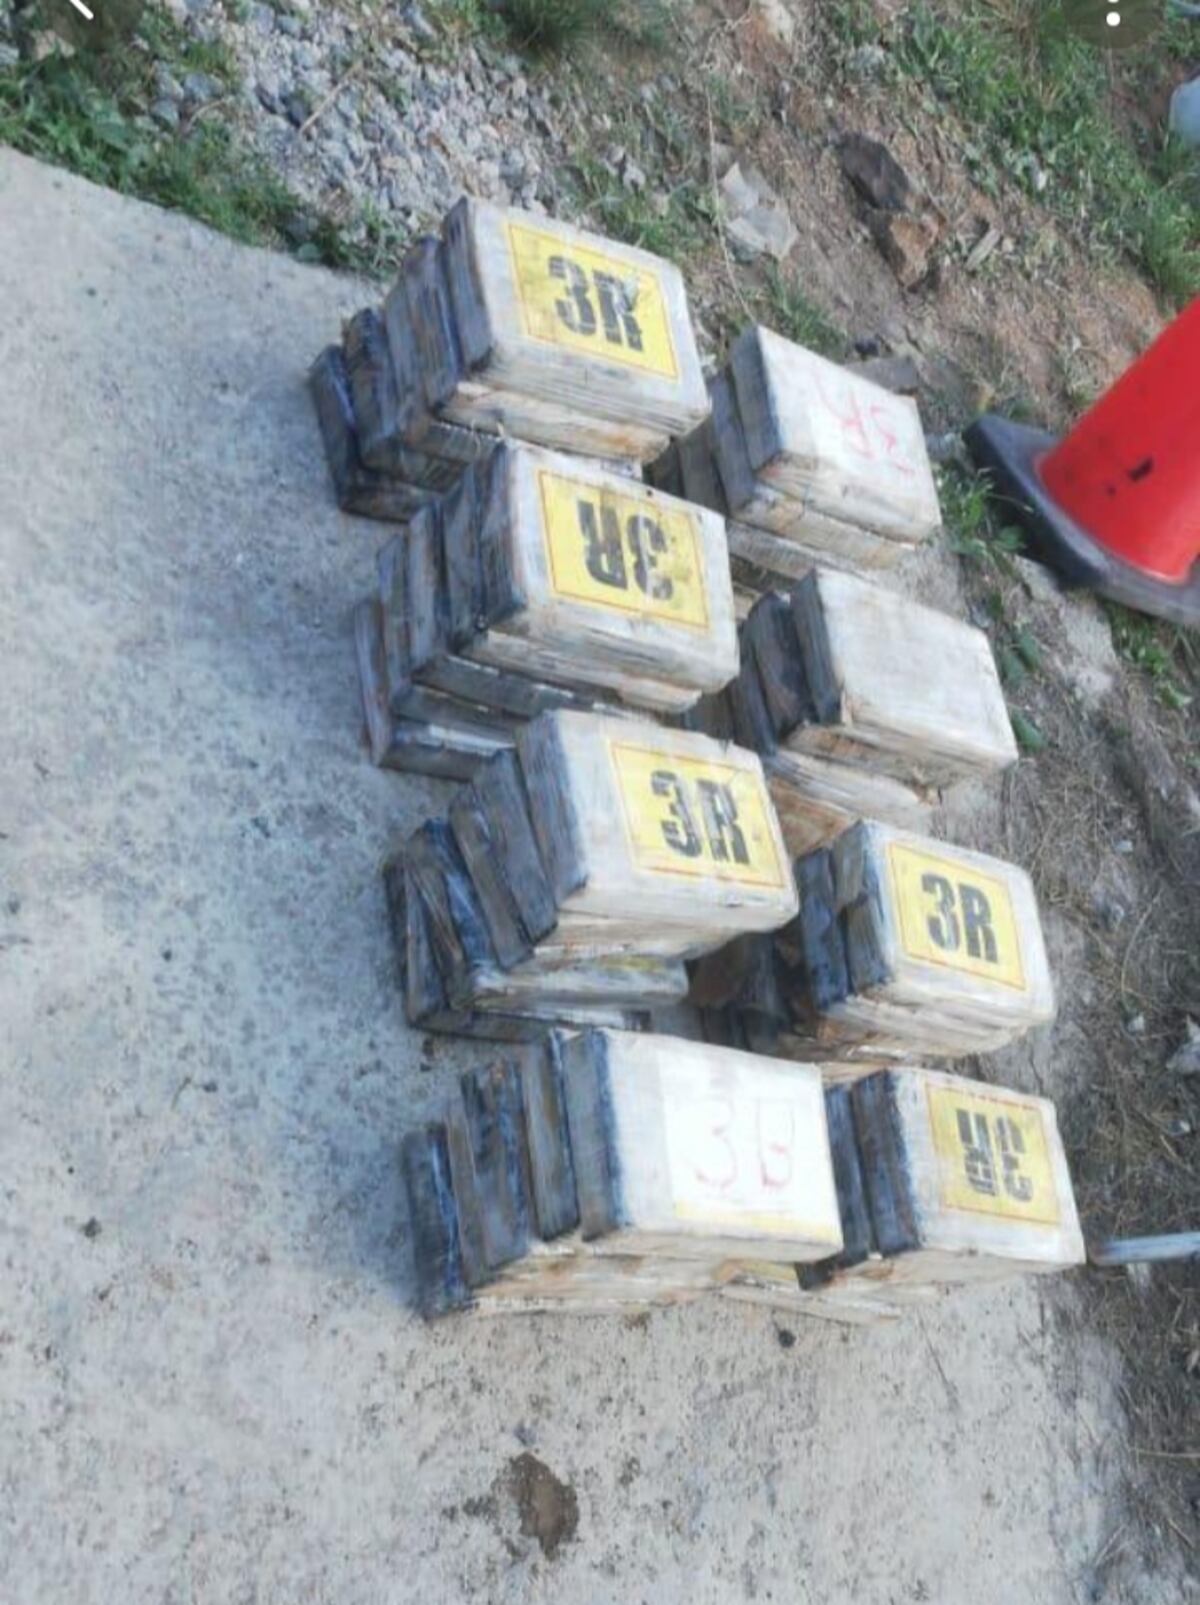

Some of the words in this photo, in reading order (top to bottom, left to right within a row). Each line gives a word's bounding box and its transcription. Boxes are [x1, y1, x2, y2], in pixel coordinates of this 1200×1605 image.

[549, 255, 643, 351] 3R
[577, 501, 674, 600] 3R
[651, 770, 750, 865] 3R
[921, 873, 998, 963] 3R
